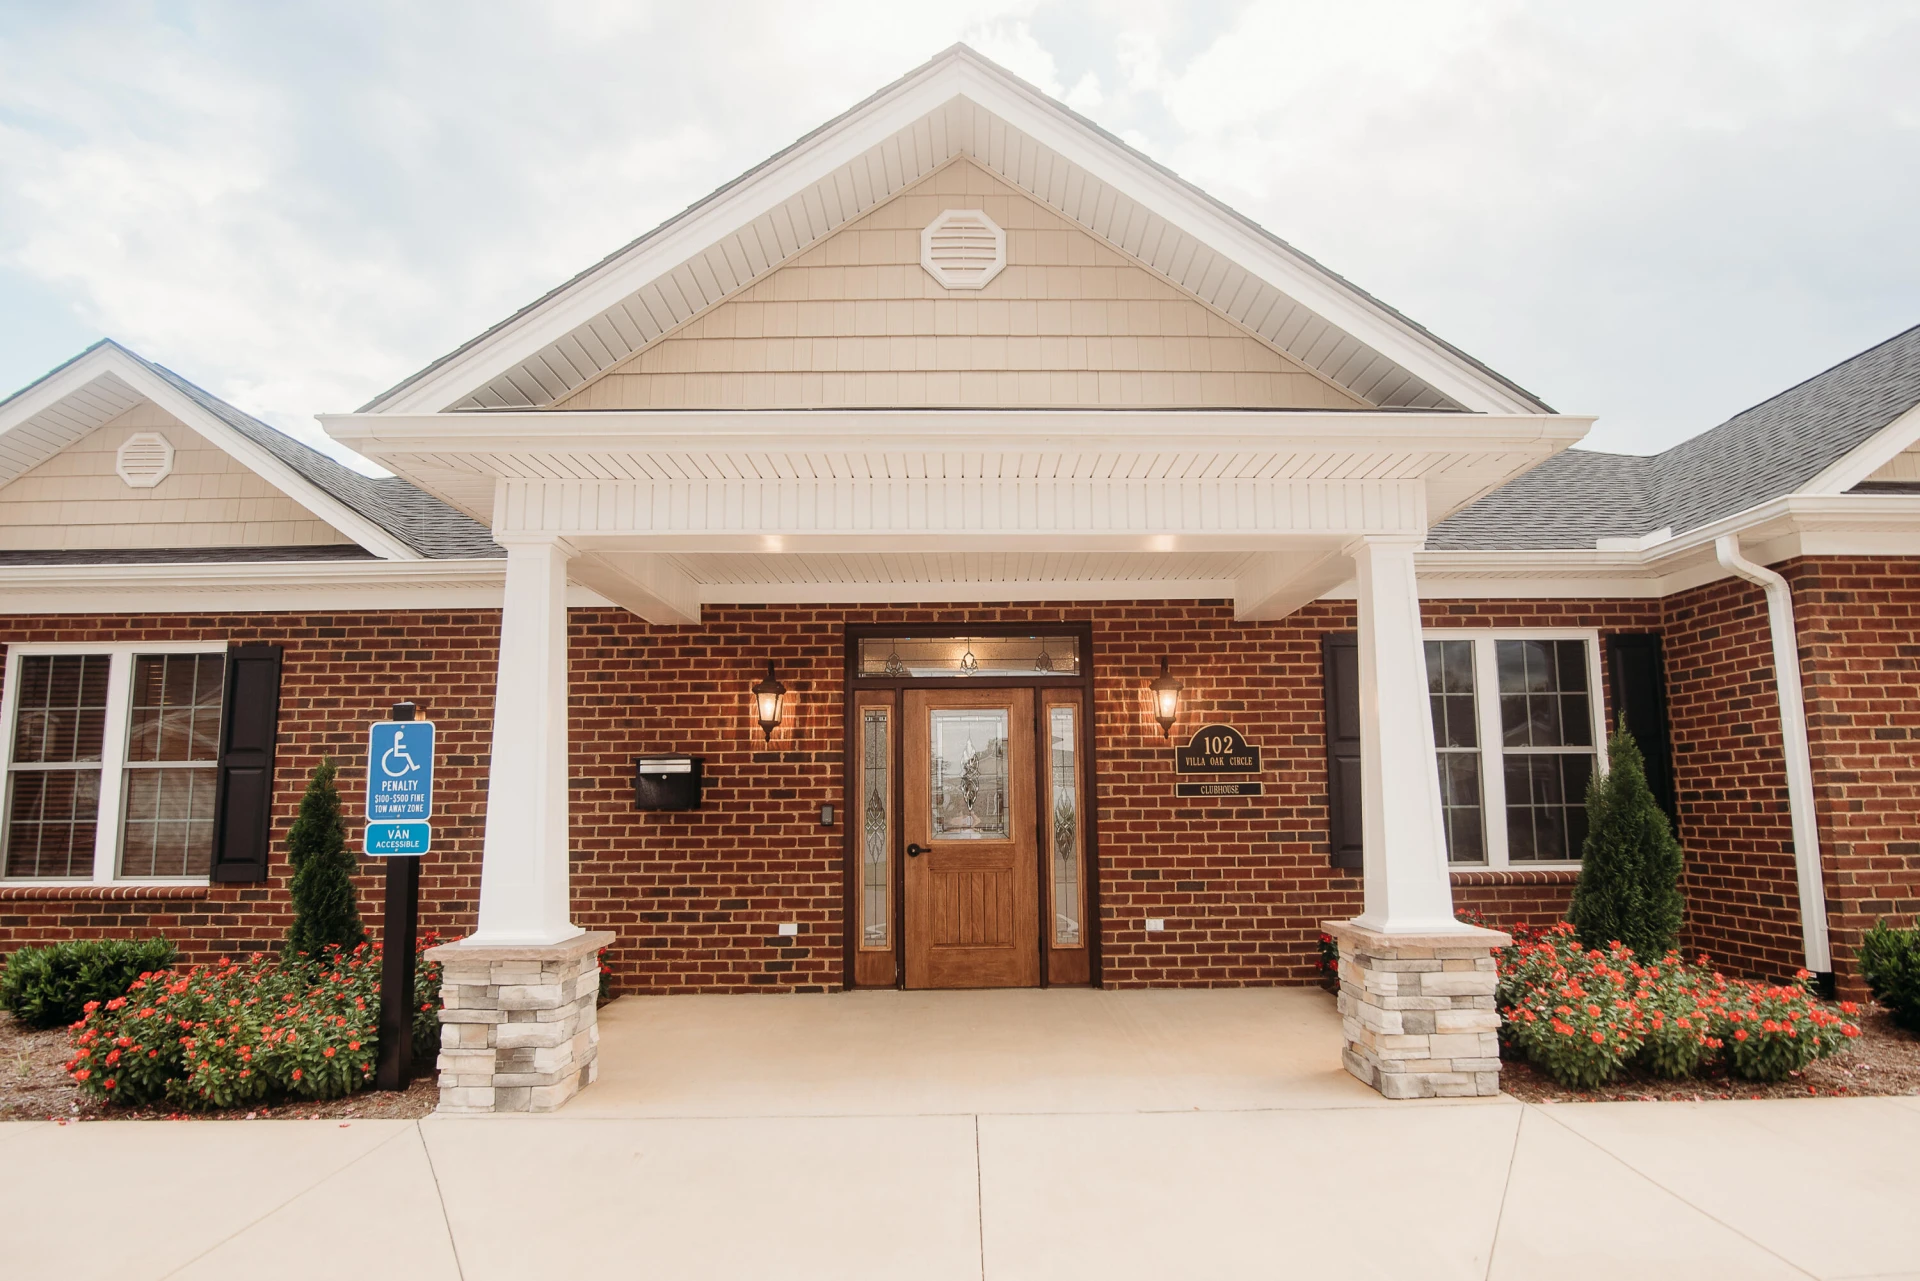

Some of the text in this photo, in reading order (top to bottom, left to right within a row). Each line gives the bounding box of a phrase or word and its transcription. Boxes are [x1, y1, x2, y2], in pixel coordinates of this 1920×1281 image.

[1204, 735, 1233, 755] 102
[1185, 757, 1253, 766] VILLA OAK CIRCLE
[381, 780, 419, 791] PENALTY
[1200, 785, 1240, 794] CLUBHOUSE
[374, 794, 425, 803] $100-$500 FINE
[375, 804, 424, 813] TOW AWAY ZONE
[387, 829, 410, 839] VAN
[376, 840, 419, 848] ACCESSIBLE
